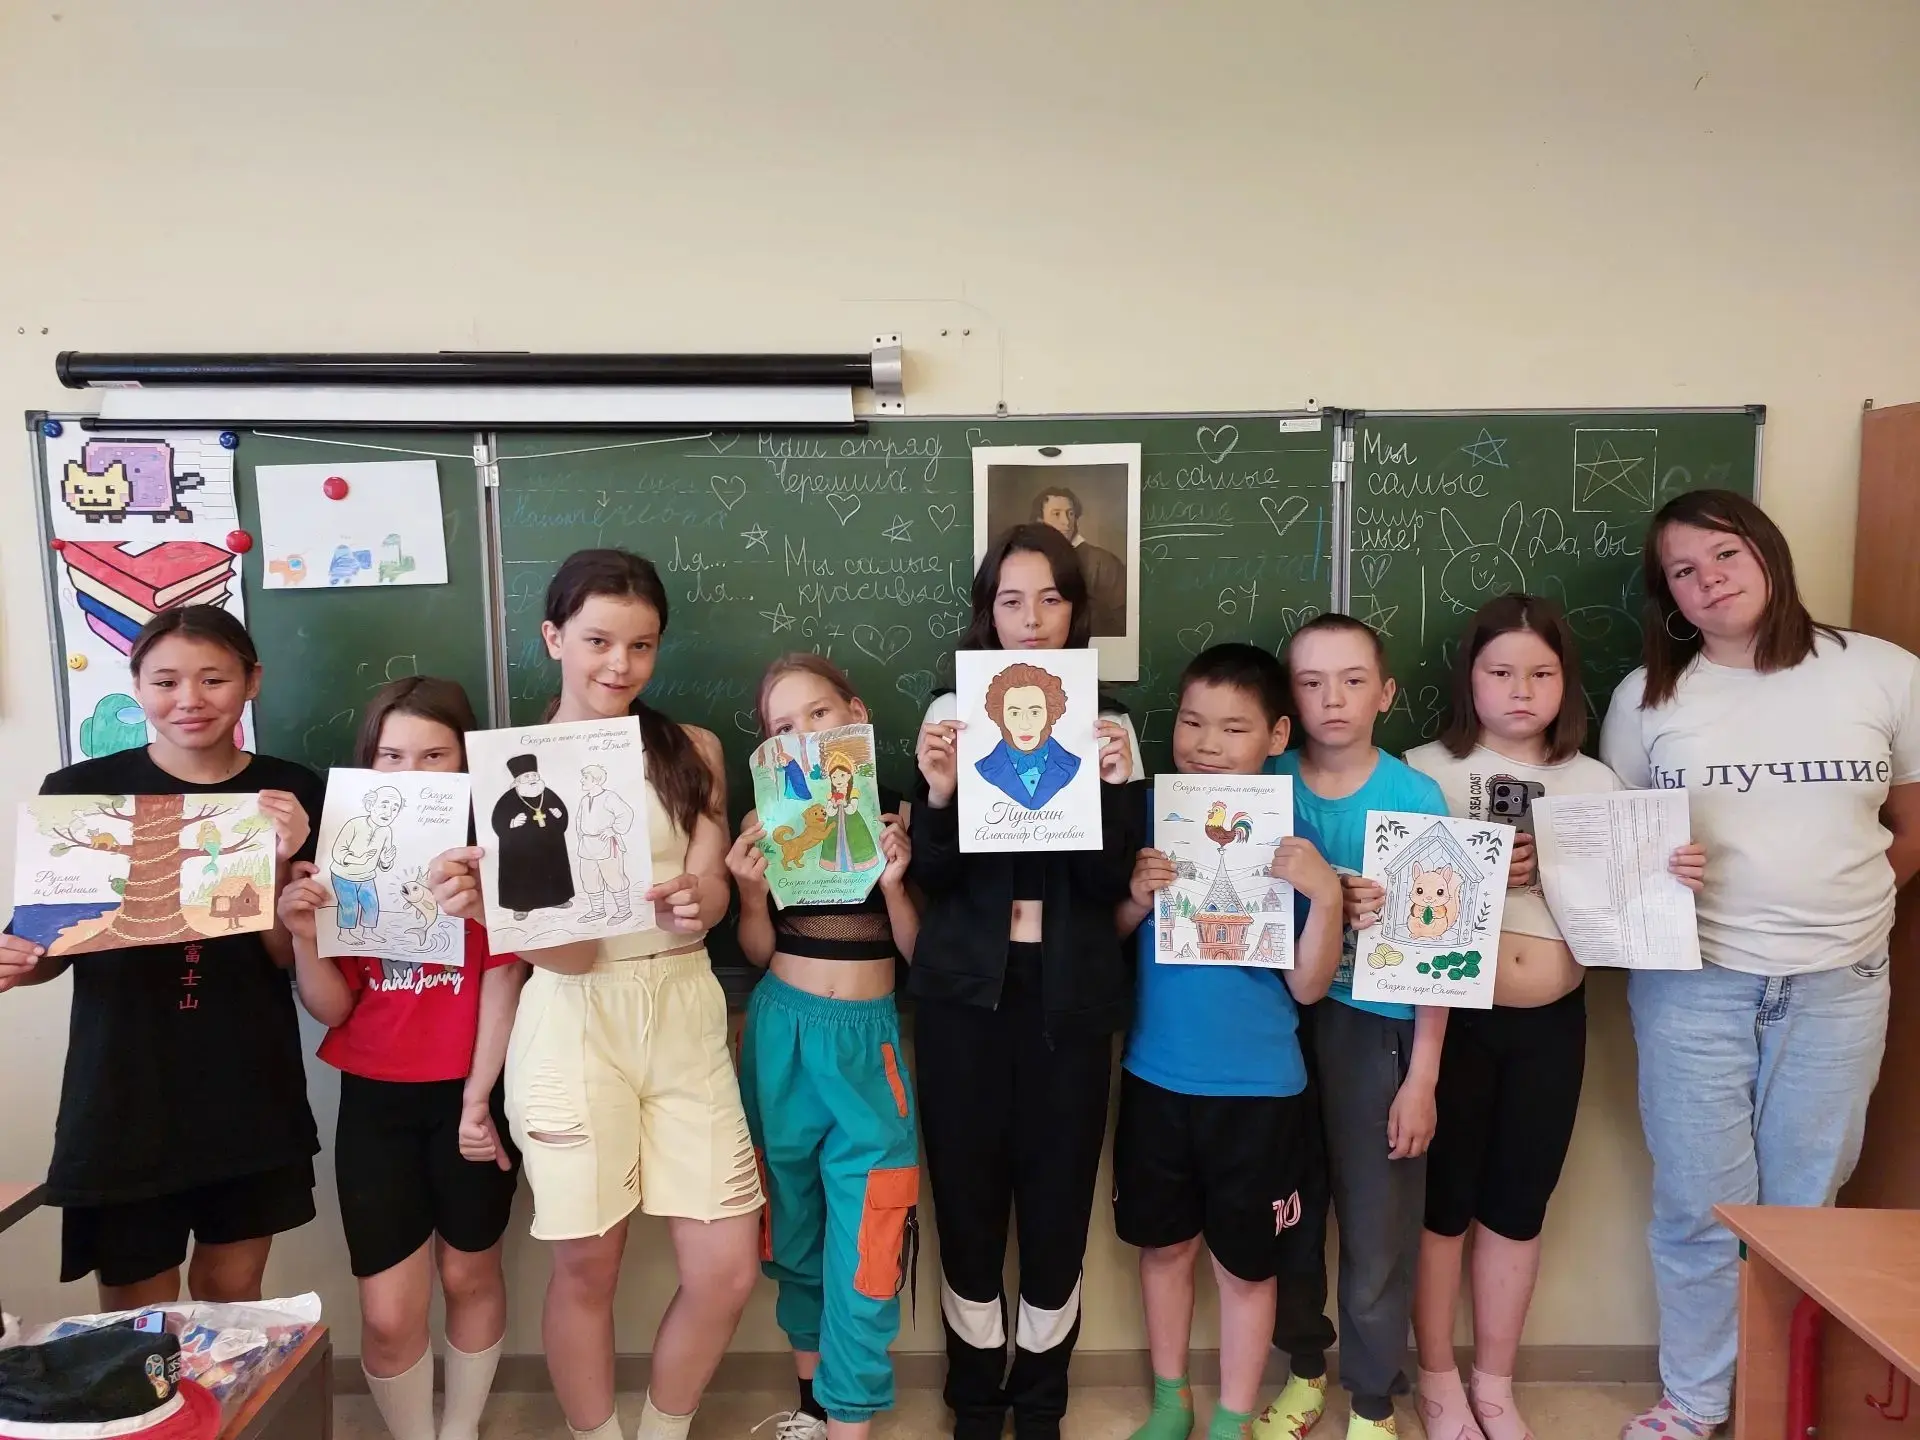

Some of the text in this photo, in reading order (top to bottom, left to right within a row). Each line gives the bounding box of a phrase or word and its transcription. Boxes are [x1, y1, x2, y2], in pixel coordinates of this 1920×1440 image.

[758, 432, 827, 458] Наш
[840, 433, 943, 481] отряд
[1363, 428, 1418, 465] Мы
[1176, 464, 1280, 490] самые
[1368, 472, 1489, 498] самые
[784, 534, 944, 577] Мы самые
[1172, 780, 1202, 795] Сказка
[1469, 772, 1482, 796] COAST
[1701, 760, 1890, 793] лучшие
[984, 801, 1064, 829] Пушкин
[1469, 797, 1481, 811] SEA
[974, 825, 1086, 844] Александр Сергеевич
[35, 870, 80, 886] Руслан
[42, 883, 98, 897] Людмила
[179, 944, 202, 1010] 富士山
[414, 966, 465, 996] Jerry
[1376, 978, 1406, 993] Сказка
